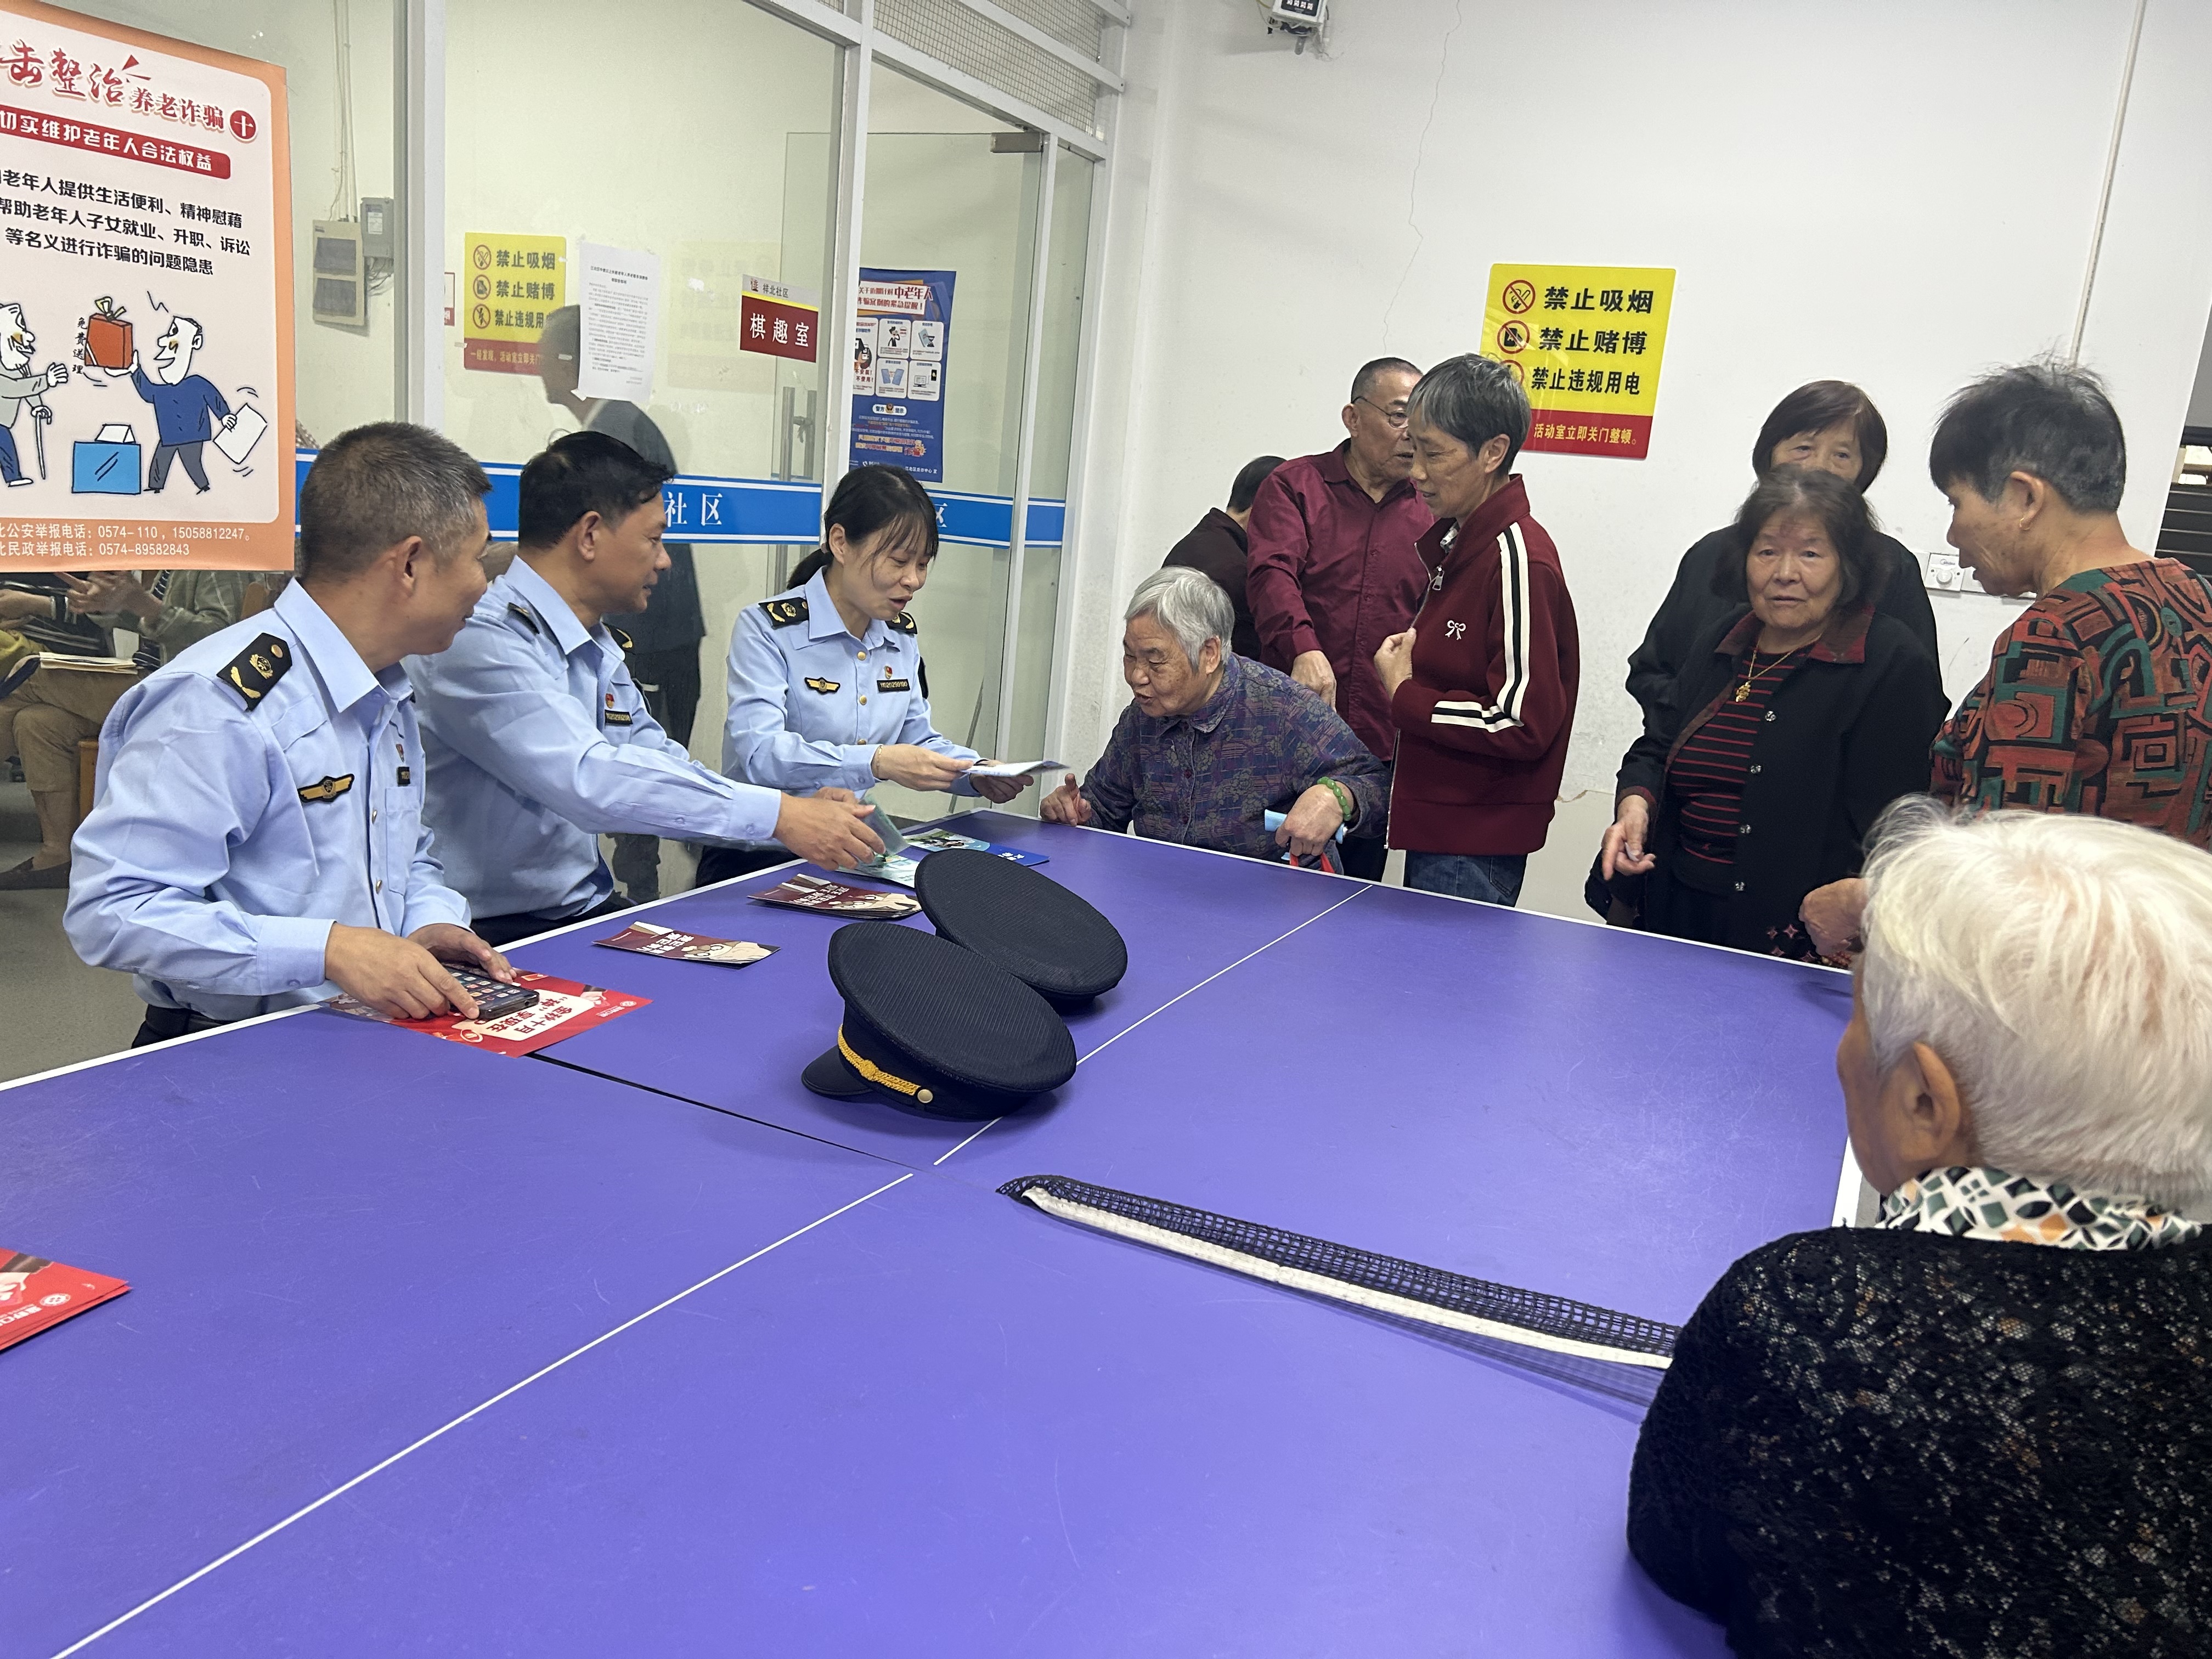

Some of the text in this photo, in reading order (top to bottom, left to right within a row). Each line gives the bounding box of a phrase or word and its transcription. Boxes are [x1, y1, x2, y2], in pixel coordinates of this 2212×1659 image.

[132, 87, 224, 129] 养老诈骗
[0, 110, 212, 171] 切实维护老年人合法权益
[0, 169, 242, 228] 老年人提供生活便利、精神慰藉
[5, 227, 213, 275] 等名义进行诈骗的问题隐患
[496, 250, 555, 270] 禁止吸烟
[496, 280, 555, 300] 禁止赌博
[763, 283, 789, 298] 祥北社区
[1544, 286, 1654, 313] 禁止吸烟
[495, 309, 547, 329] 禁止违规用
[749, 313, 809, 347] 棋趣室
[1538, 328, 1647, 354] 禁止赌博
[1531, 367, 1640, 395] 禁止违规用电
[664, 492, 723, 527] 社区
[513, 1006, 573, 1034] 金秋十月
